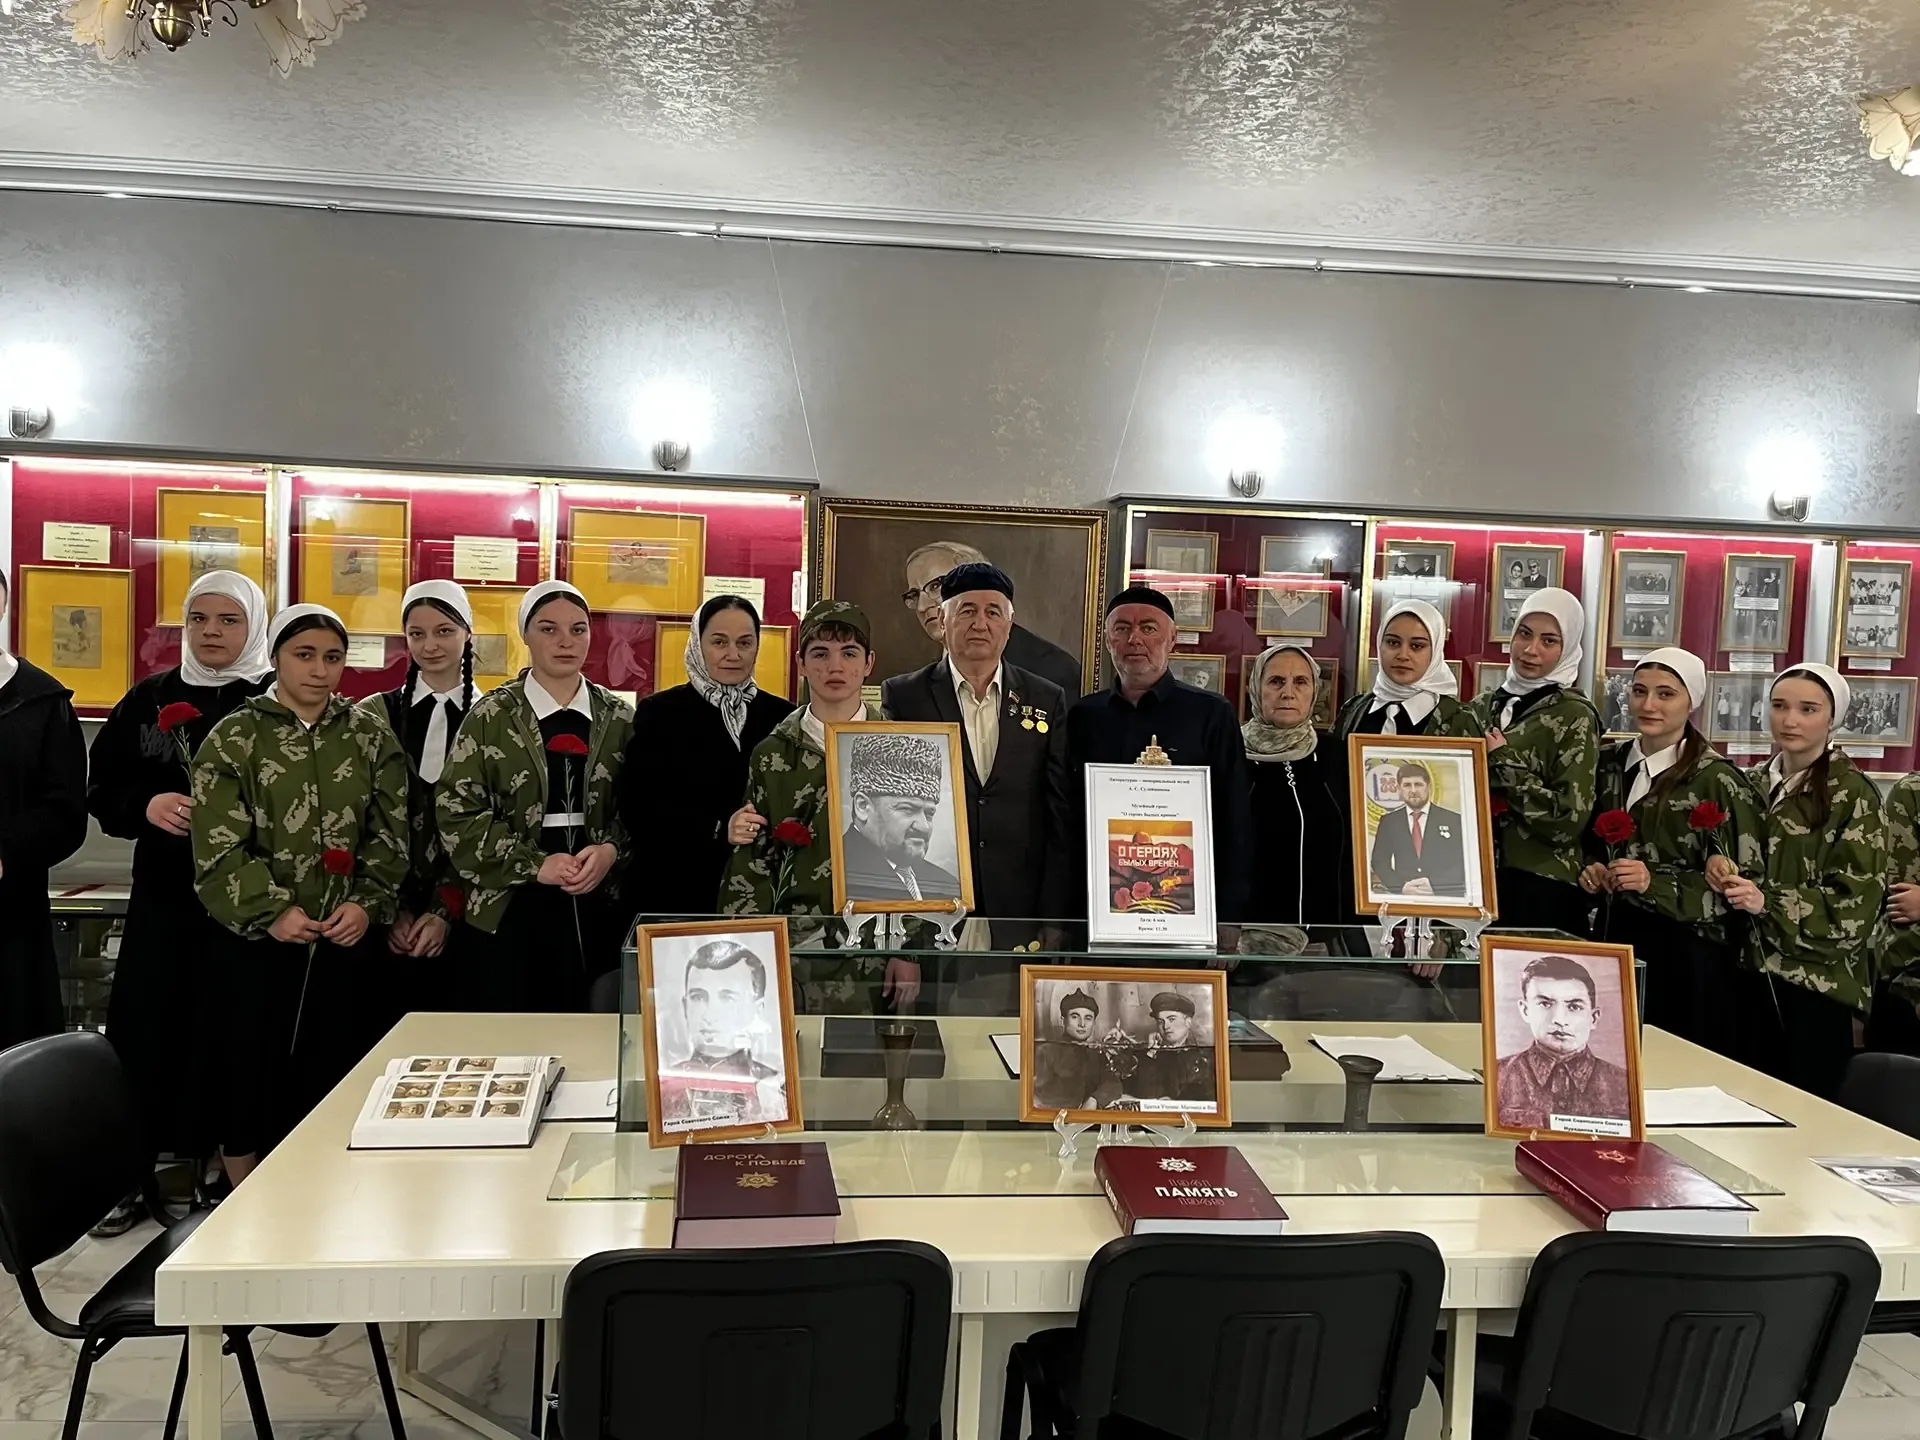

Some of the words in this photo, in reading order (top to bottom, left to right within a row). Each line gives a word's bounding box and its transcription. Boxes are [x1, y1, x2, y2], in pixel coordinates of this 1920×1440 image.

[1118, 846, 1126, 857] О
[1128, 846, 1179, 859] ГЕРОЯХ
[1118, 859, 1147, 867] БЫЛЫХ
[681, 1117, 712, 1125] Советского
[703, 1153, 766, 1161] ДОРОГА
[748, 1159, 806, 1167] ПОБЕДЕ
[1154, 1186, 1239, 1198] ПАМЯТЬ
